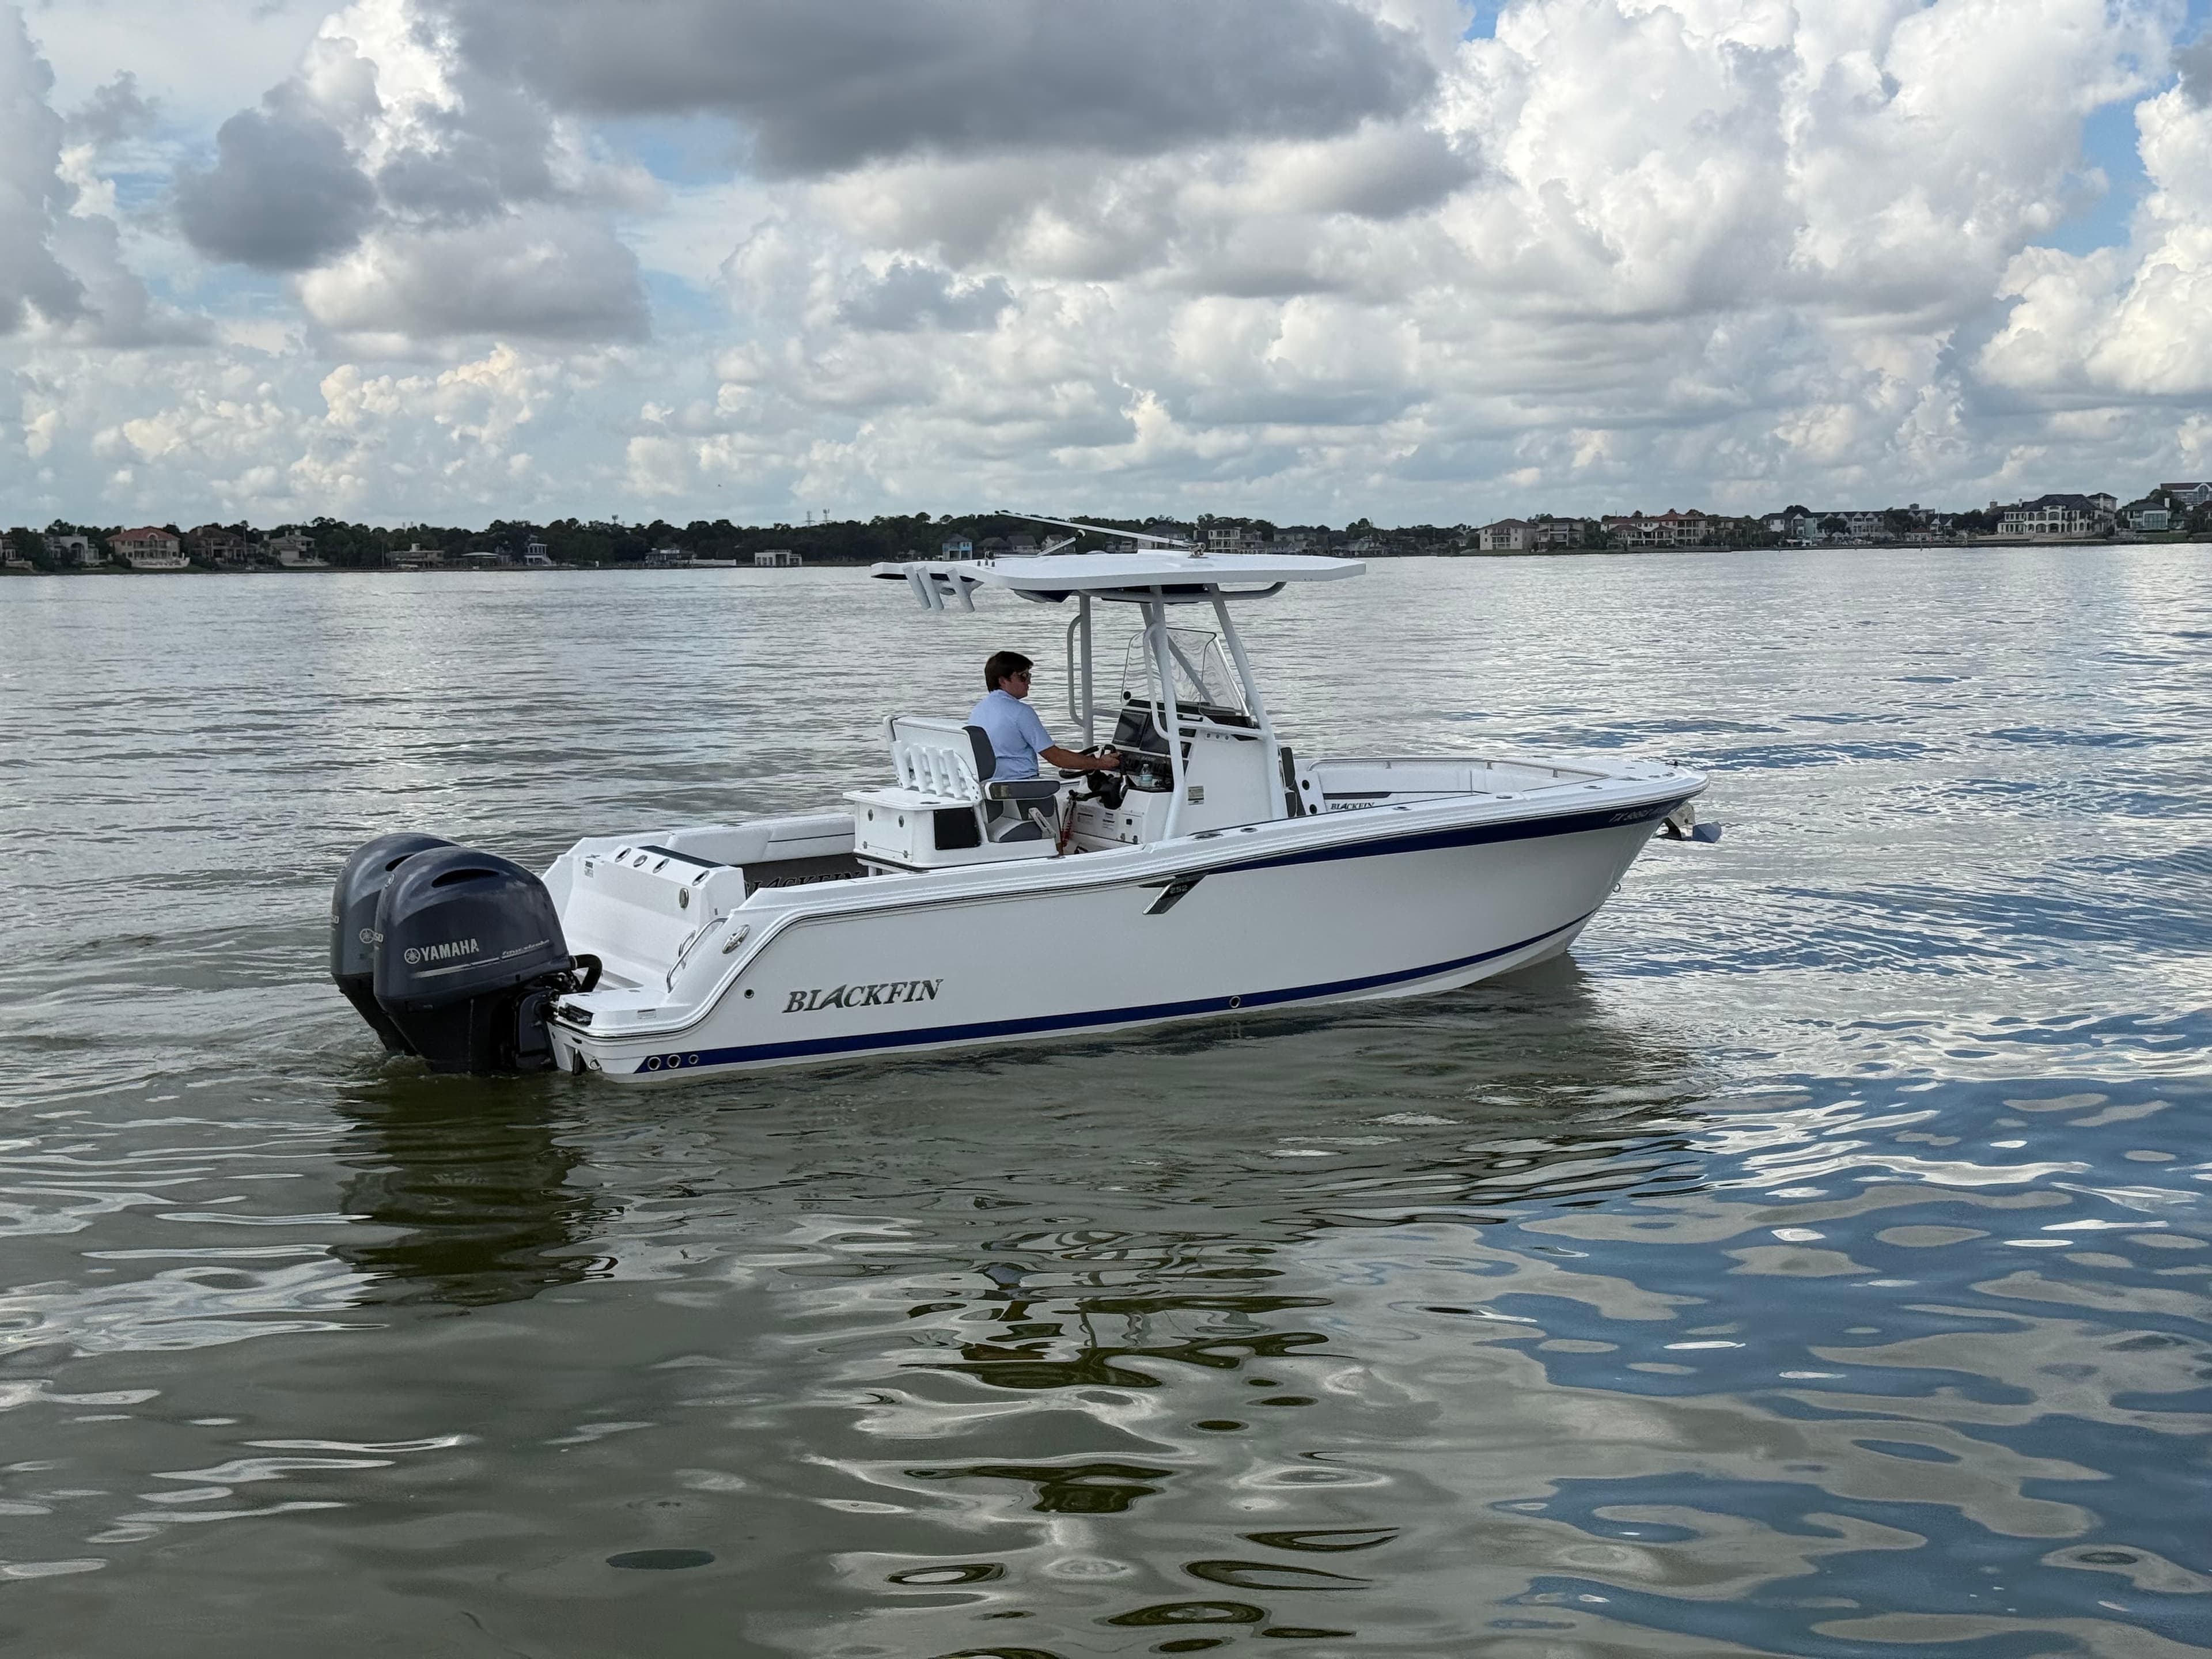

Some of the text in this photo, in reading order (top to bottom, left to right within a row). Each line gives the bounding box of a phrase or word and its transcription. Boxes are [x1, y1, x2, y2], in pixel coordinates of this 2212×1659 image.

[1331, 802, 1375, 810] BLACKFIN
[1170, 885, 1188, 894] 252
[421, 938, 480, 961] YAMAHA
[781, 979, 944, 1013] BLACKFIN
